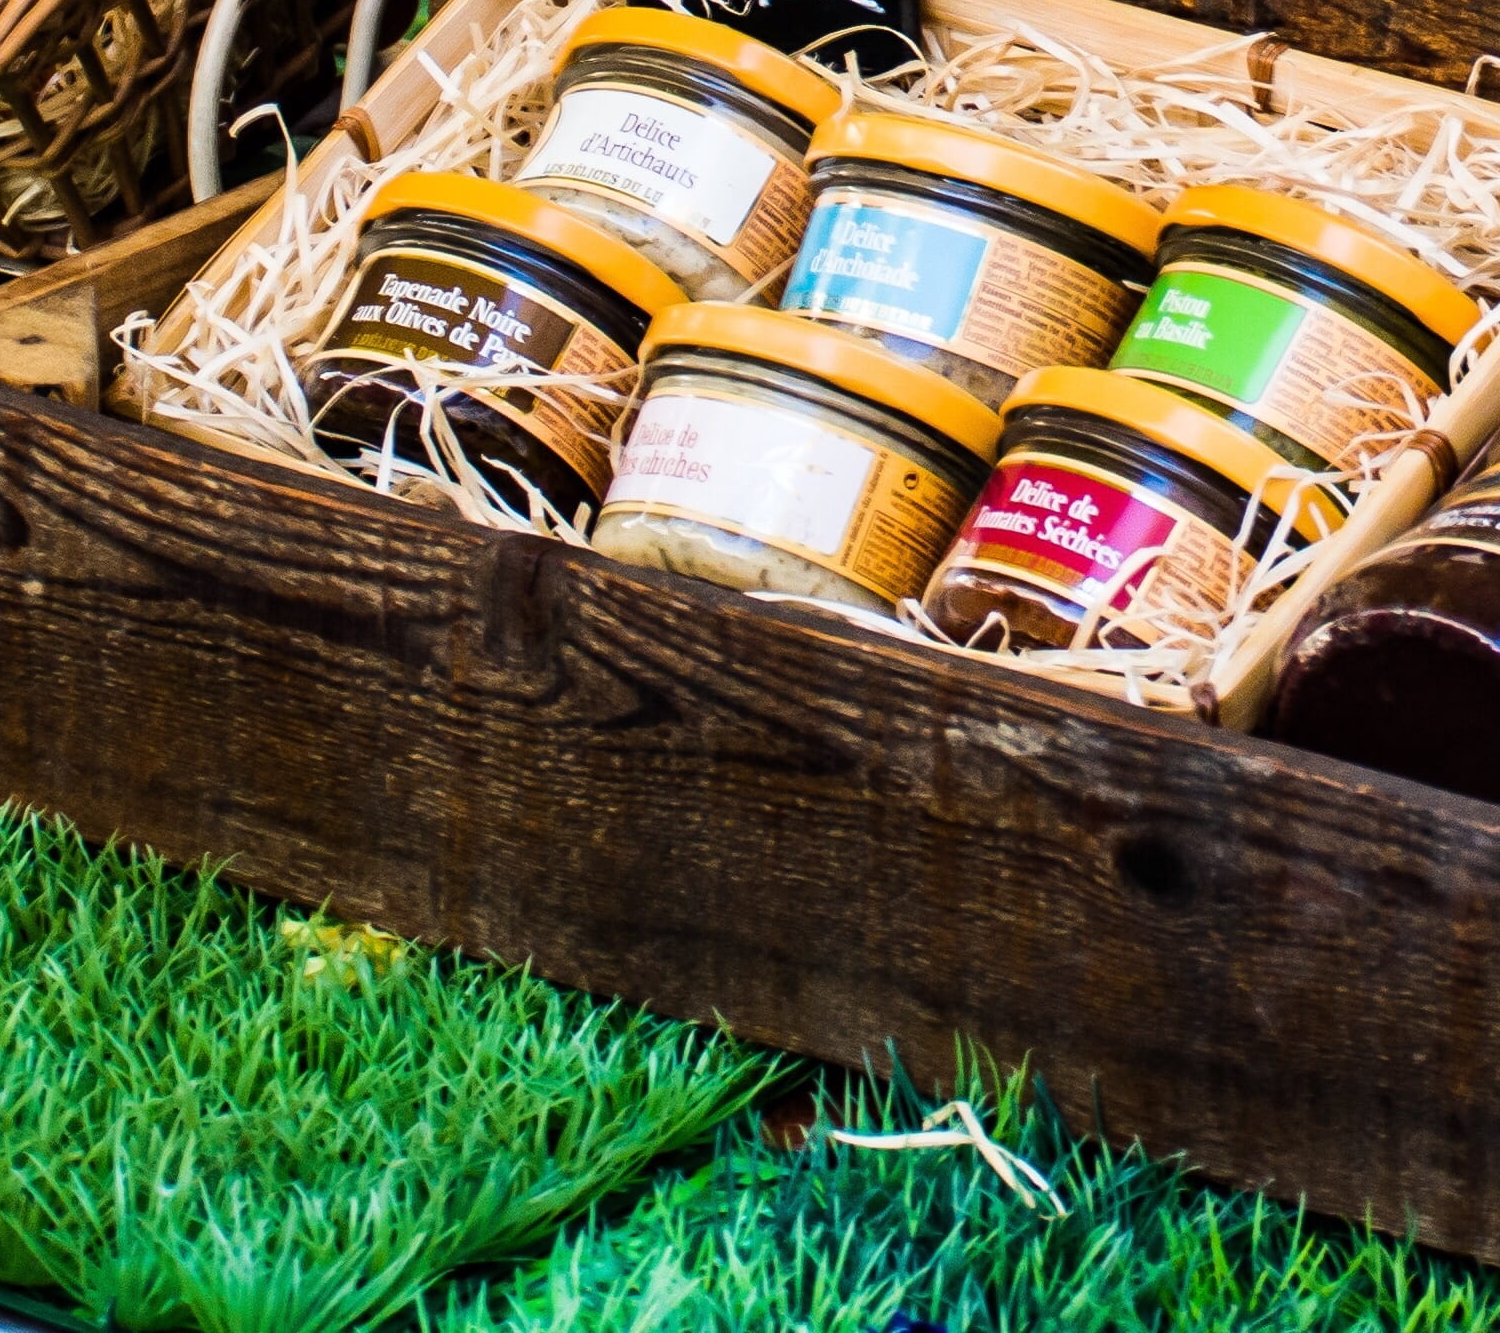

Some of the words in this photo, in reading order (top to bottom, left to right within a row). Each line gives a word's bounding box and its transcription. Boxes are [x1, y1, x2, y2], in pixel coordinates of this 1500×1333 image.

[620, 112, 682, 152] Délice
[579, 132, 700, 191] d'Artichauts
[352, 303, 381, 324] aux
[384, 301, 447, 339] Olives
[449, 324, 478, 351] de
[377, 272, 466, 316] Tapenade
[471, 296, 532, 345] Noire
[1158, 289, 1211, 319] Pistou
[1152, 316, 1214, 350] Basilic
[1010, 478, 1068, 512] Délice
[1068, 494, 1099, 524] de
[973, 505, 1038, 535] Tomates
[1037, 515, 1123, 570] Séchées
